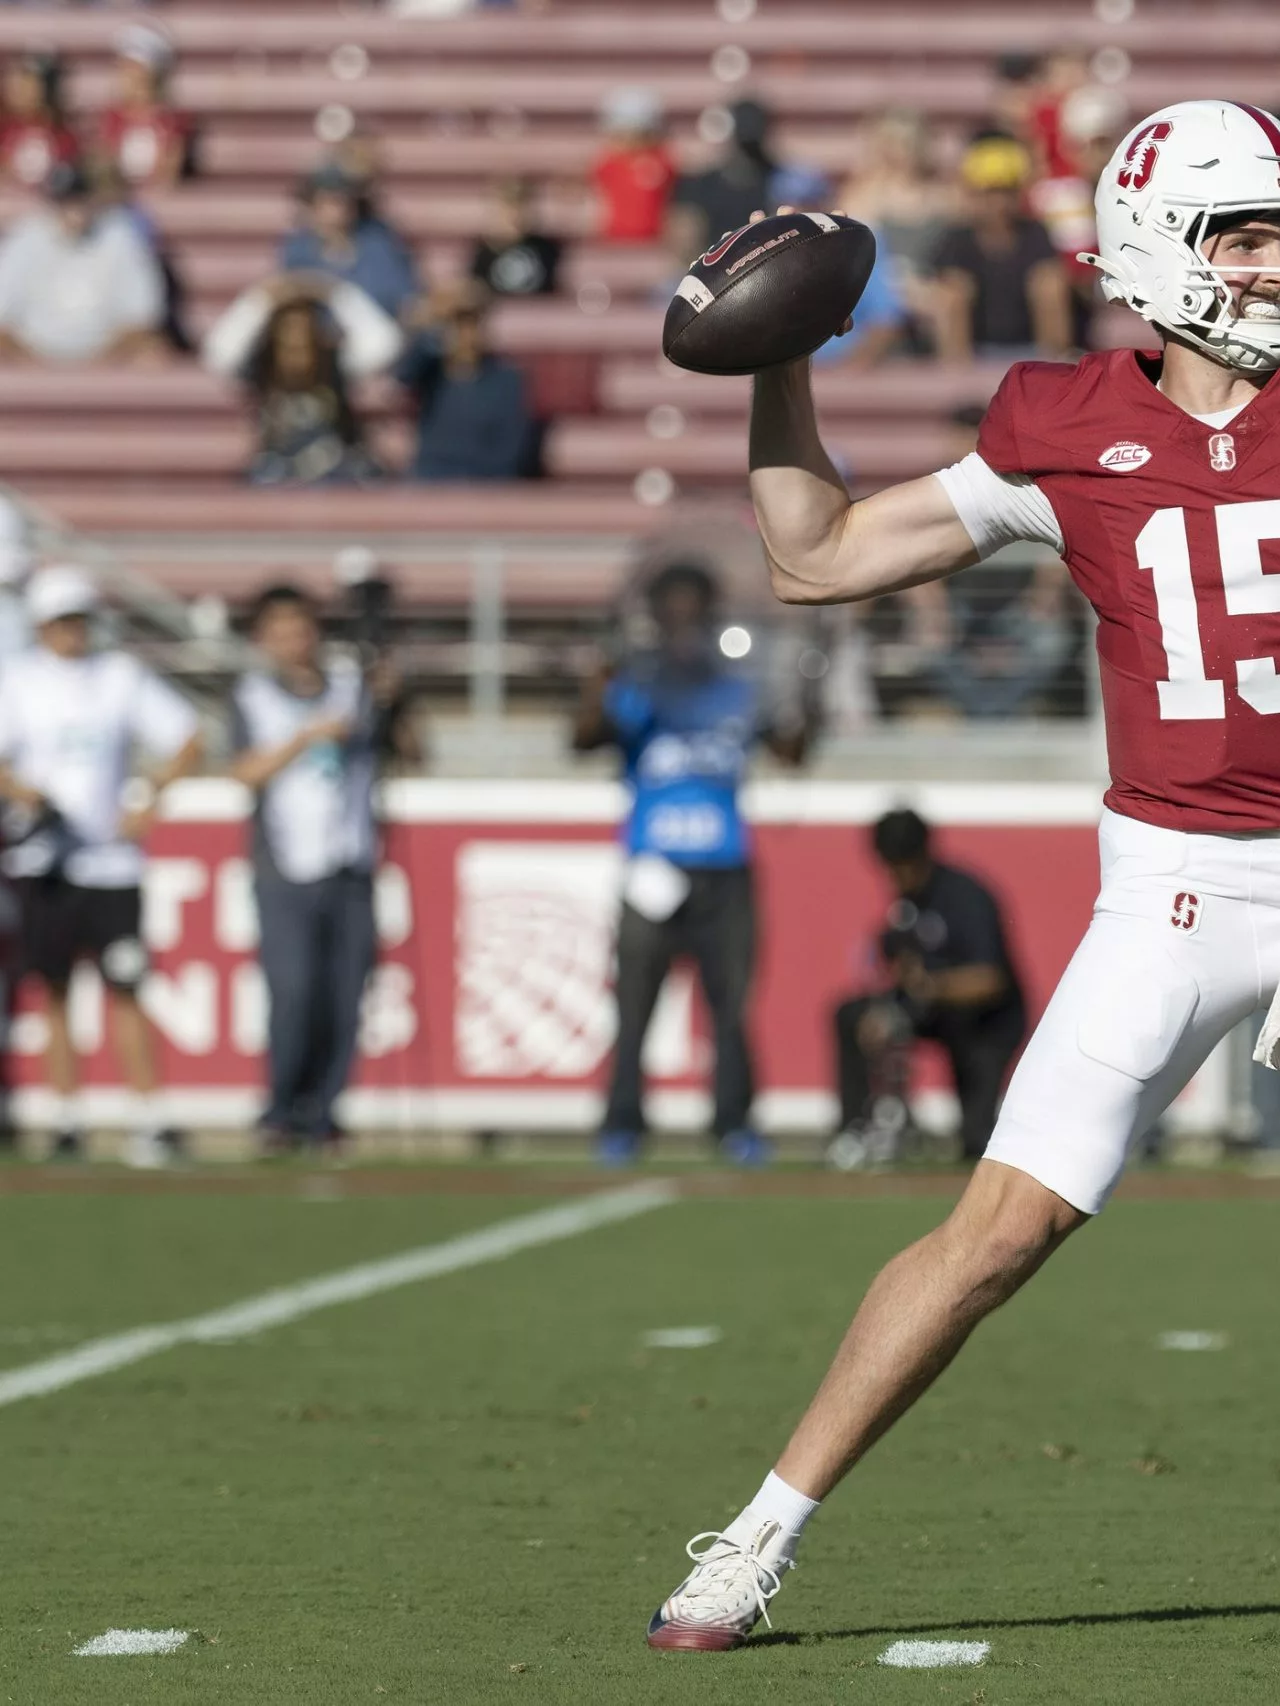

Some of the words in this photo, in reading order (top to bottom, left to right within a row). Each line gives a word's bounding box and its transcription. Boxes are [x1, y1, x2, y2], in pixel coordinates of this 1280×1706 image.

[725, 245, 766, 276] VAPOR
[763, 228, 800, 251] ELITE
[1106, 447, 1145, 463] ACC
